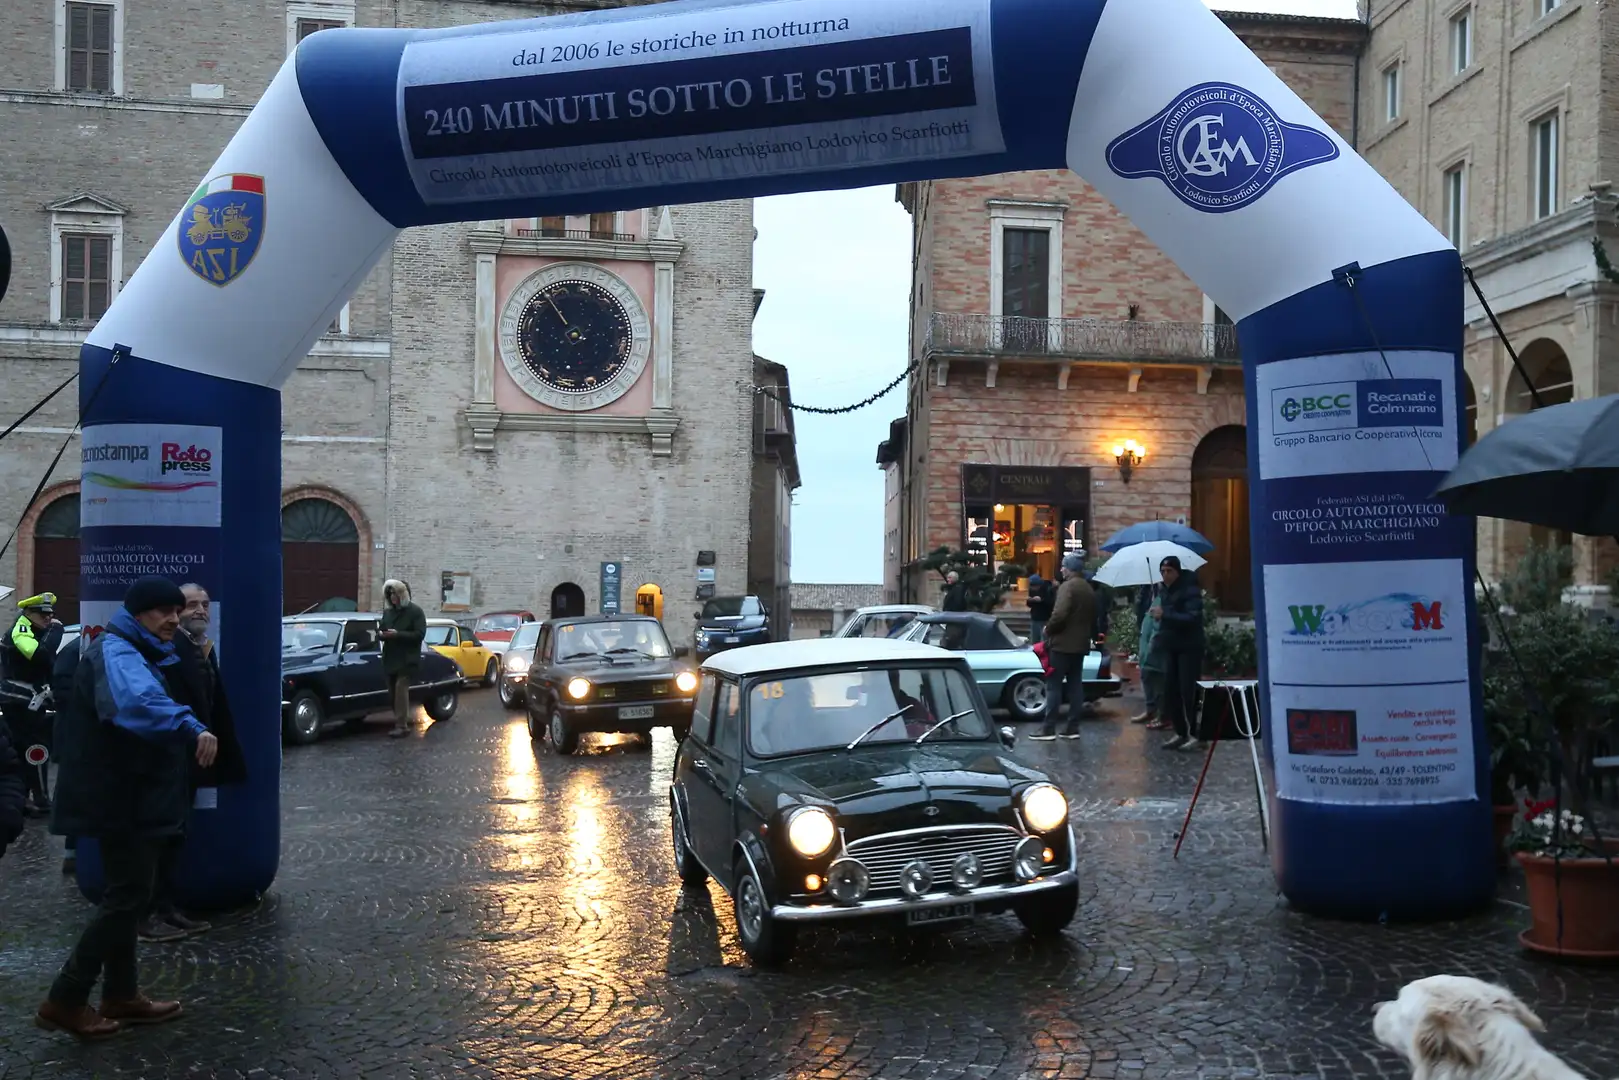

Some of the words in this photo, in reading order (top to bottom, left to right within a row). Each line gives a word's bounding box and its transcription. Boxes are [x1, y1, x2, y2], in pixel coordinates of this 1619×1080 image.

[512, 47, 545, 67] dal
[551, 42, 600, 63] 2006
[606, 40, 624, 57] le
[630, 29, 717, 55] storiche
[723, 27, 745, 44] in
[751, 17, 850, 41] notturna
[424, 106, 474, 136] 240
[481, 91, 619, 132] MINUTI
[628, 78, 753, 118] SOTTO
[762, 72, 807, 104] LE
[815, 55, 952, 99] STELLE
[1229, 92, 1264, 118] d'Epoca
[1162, 89, 1228, 145] Automotoveicoli
[429, 167, 487, 184] Circolo
[490, 154, 622, 179] Automotoveicoli
[626, 151, 693, 168] d'Epoca
[696, 139, 803, 161] Marchigiano
[807, 131, 888, 151] Lodovico
[892, 119, 971, 141] Scarfiotti
[1261, 116, 1281, 174] Marchigiano
[1161, 144, 1179, 182] Circolo
[1183, 184, 1221, 205] Lodovico
[1222, 180, 1261, 204] Scarfiotti
[1302, 394, 1351, 411] BCC
[1367, 390, 1427, 402] Recanati
[1429, 394, 1436, 402] e
[1367, 402, 1437, 414] Colmurano
[1274, 436, 1306, 448] Gruppo
[1308, 432, 1351, 443] Bancario
[1354, 429, 1417, 442] Cooperativo
[161, 442, 212, 462] Roto
[161, 460, 212, 475] press
[1317, 496, 1352, 506] Federato
[1355, 494, 1369, 504] ASI
[1371, 493, 1385, 503] dal
[1272, 508, 1322, 521] CIRCOLO
[1325, 503, 1446, 518] AUTOMOTOVEICOL
[1284, 520, 1337, 533] D'EPOCA
[1340, 516, 1440, 530] MARCHIGIANO
[1309, 532, 1362, 545] Lodovico
[1364, 530, 1415, 542] Scarfiotti
[95, 553, 205, 564] AUTOMOTOVEICOLI
[103, 564, 189, 574] MARCHIGIANO
[1412, 762, 1456, 773] TOLENTINO
